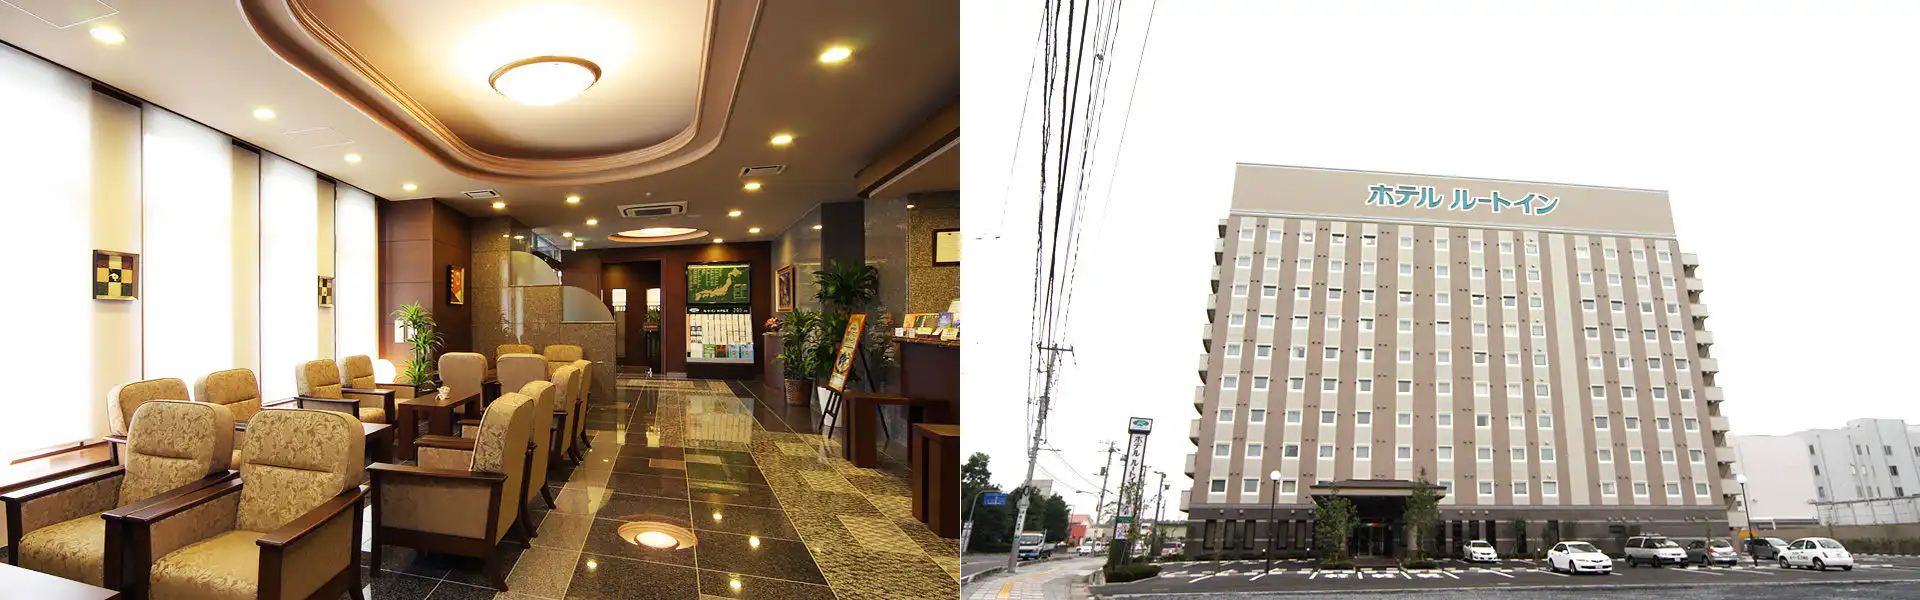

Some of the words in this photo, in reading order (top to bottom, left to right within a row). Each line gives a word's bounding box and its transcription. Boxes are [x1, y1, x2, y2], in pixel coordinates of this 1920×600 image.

[1367, 184, 1442, 208] ホテル
[1450, 189, 1559, 214] ルートイン
[1132, 436, 1143, 457] ホテル
